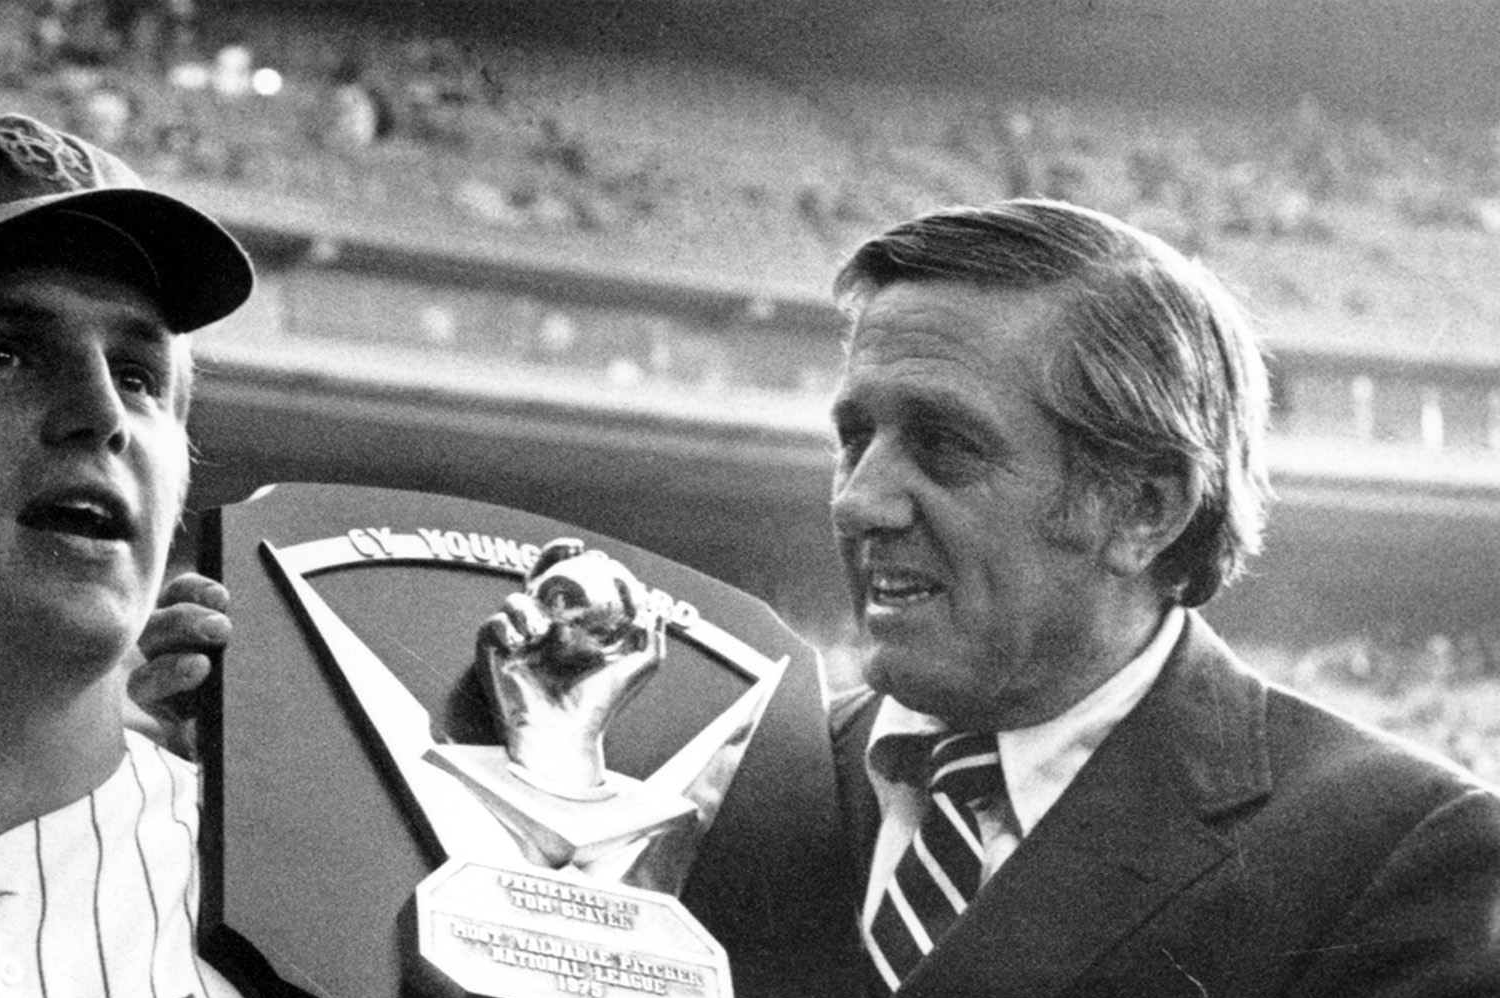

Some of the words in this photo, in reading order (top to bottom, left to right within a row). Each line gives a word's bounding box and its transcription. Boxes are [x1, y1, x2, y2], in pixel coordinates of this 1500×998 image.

[347, 526, 395, 558] CY
[417, 526, 542, 572] YOUNG
[510, 890, 554, 915] TOM
[560, 902, 634, 931] SEAVER
[452, 921, 505, 945] MOST
[512, 933, 615, 967] VALUABLE
[618, 956, 704, 987] PITCHER
[491, 946, 586, 979] NATIONAL
[594, 966, 668, 997] LEAGUE
